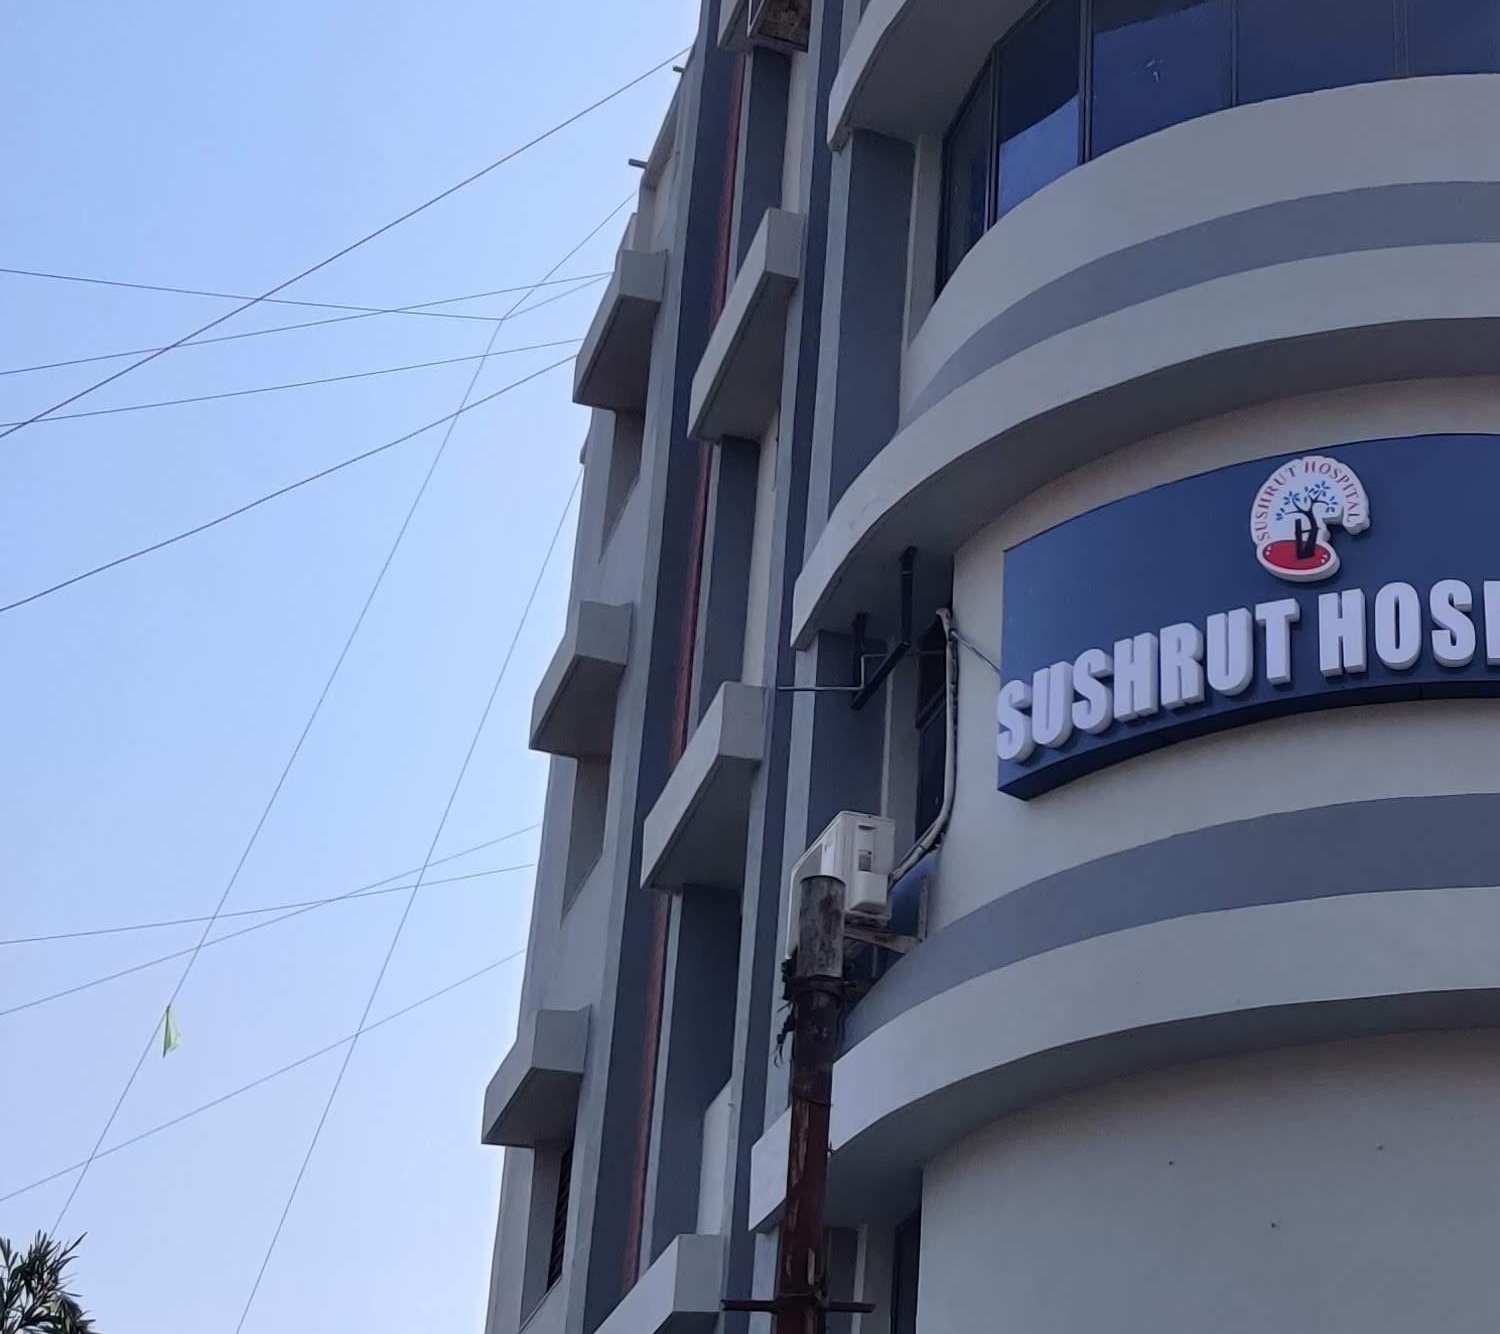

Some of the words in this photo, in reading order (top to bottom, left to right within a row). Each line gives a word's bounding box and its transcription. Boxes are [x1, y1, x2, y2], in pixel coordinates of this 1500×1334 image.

[1256, 465, 1297, 542] SUSHRUT
[1304, 460, 1361, 524] HOSPITAL
[997, 598, 1299, 763] SUSHRUT
